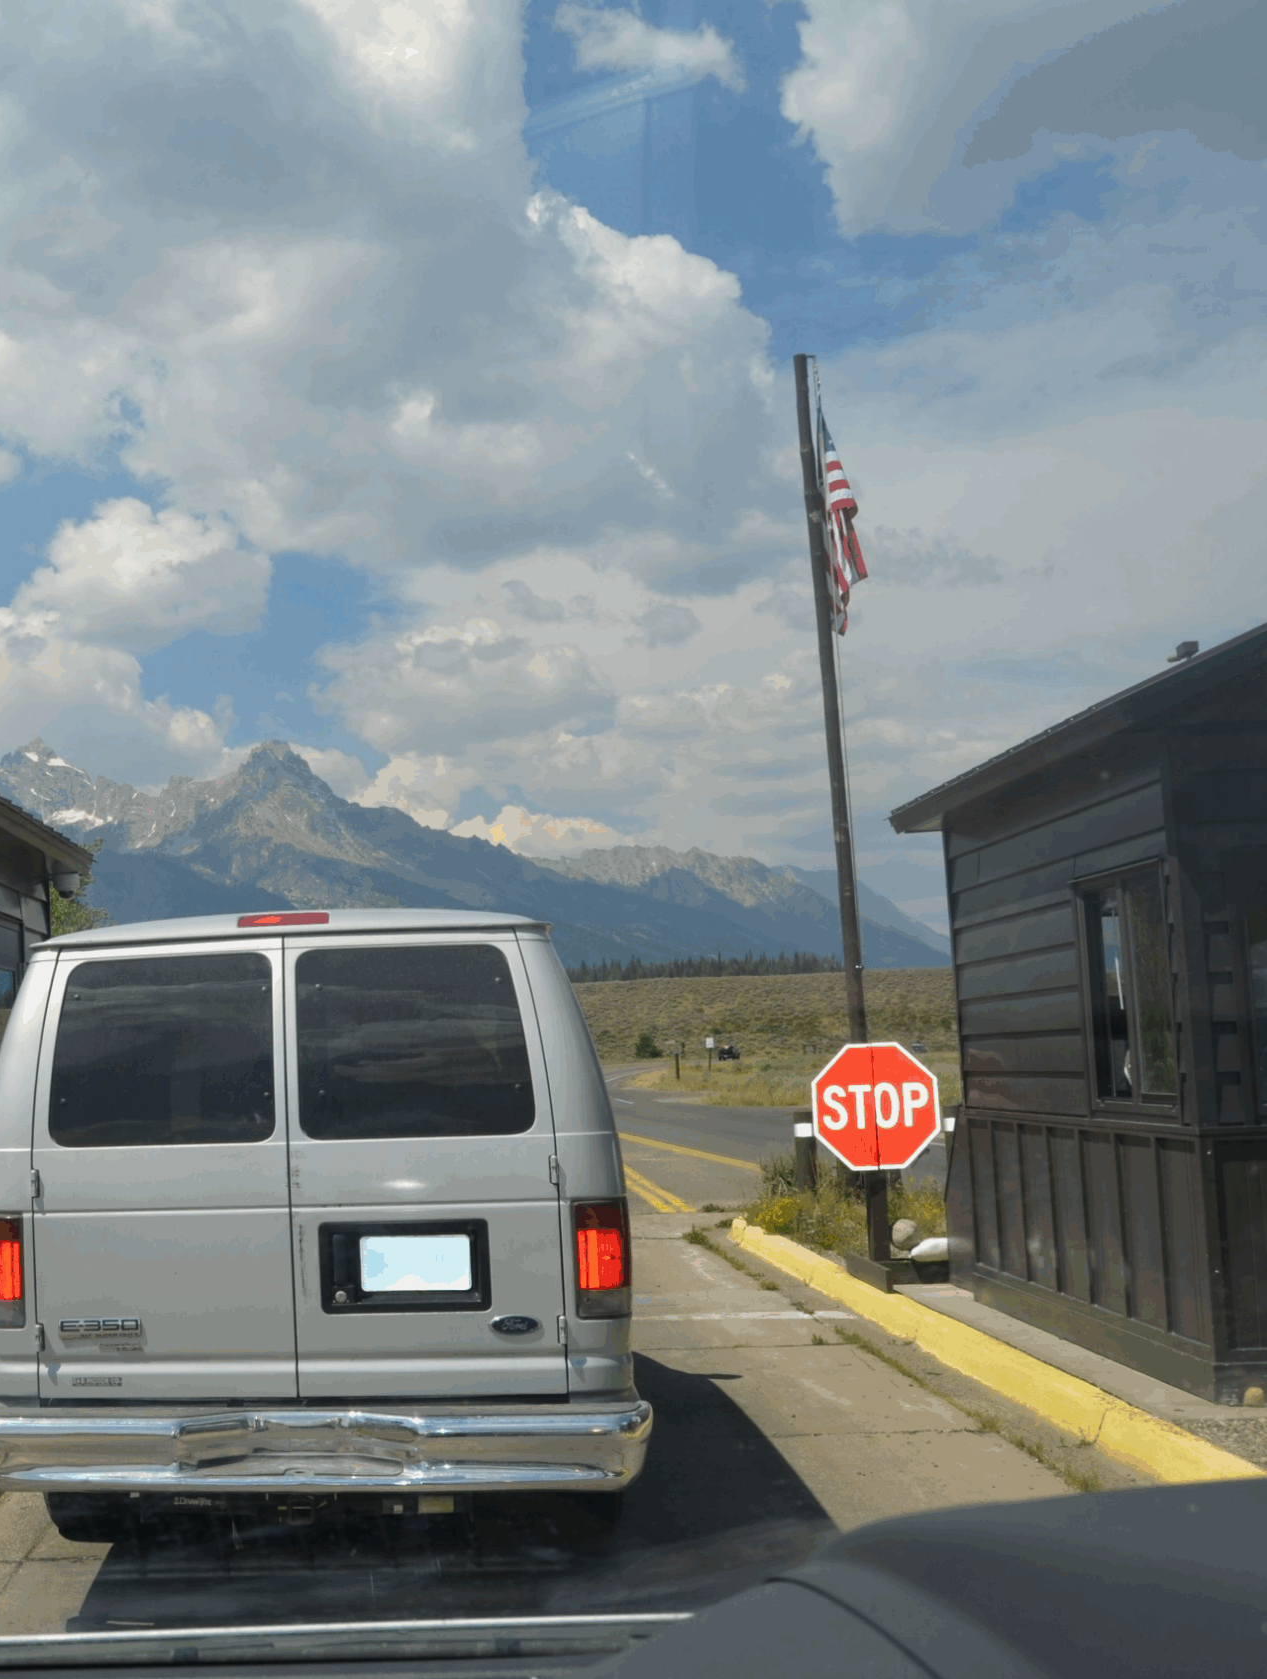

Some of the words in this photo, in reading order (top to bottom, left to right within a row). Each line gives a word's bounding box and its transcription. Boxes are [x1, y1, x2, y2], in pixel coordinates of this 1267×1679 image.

[822, 1081, 930, 1131] STOP
[60, 1319, 139, 1332] E-350
[501, 1318, 529, 1330] Ford
